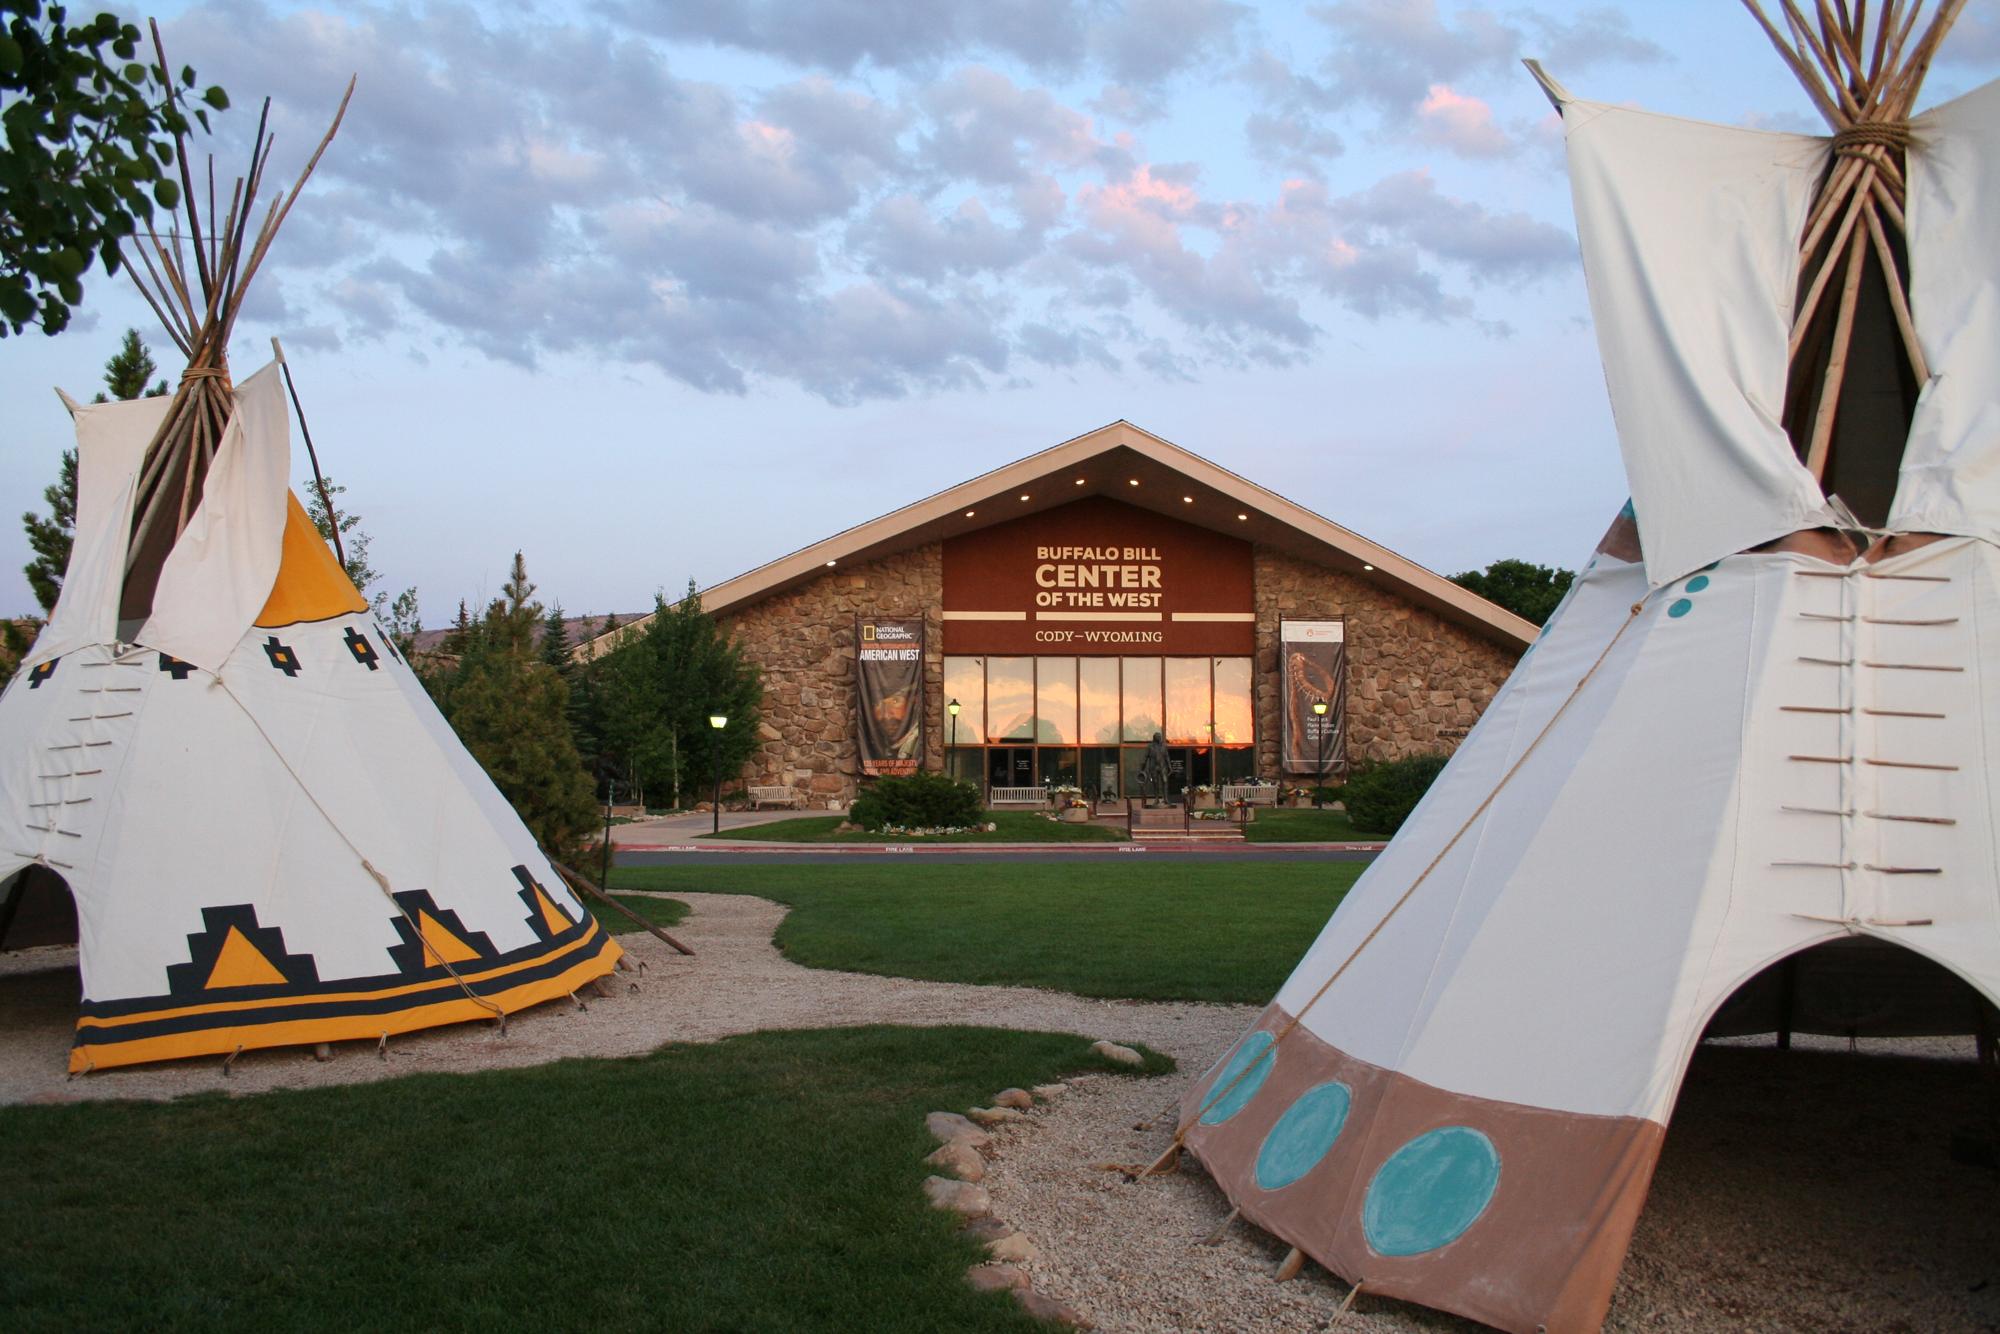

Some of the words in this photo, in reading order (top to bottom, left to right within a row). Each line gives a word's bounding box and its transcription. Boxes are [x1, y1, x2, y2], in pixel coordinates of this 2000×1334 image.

[1037, 546, 1119, 560] BUFFALO
[1123, 547, 1161, 560] BILL
[1035, 563, 1162, 588] CENTER
[1036, 592, 1062, 606] OF
[1066, 592, 1104, 606] THE
[1107, 593, 1162, 607] WEST
[860, 649, 898, 661] AMERICAN
[899, 649, 920, 661] WEST
